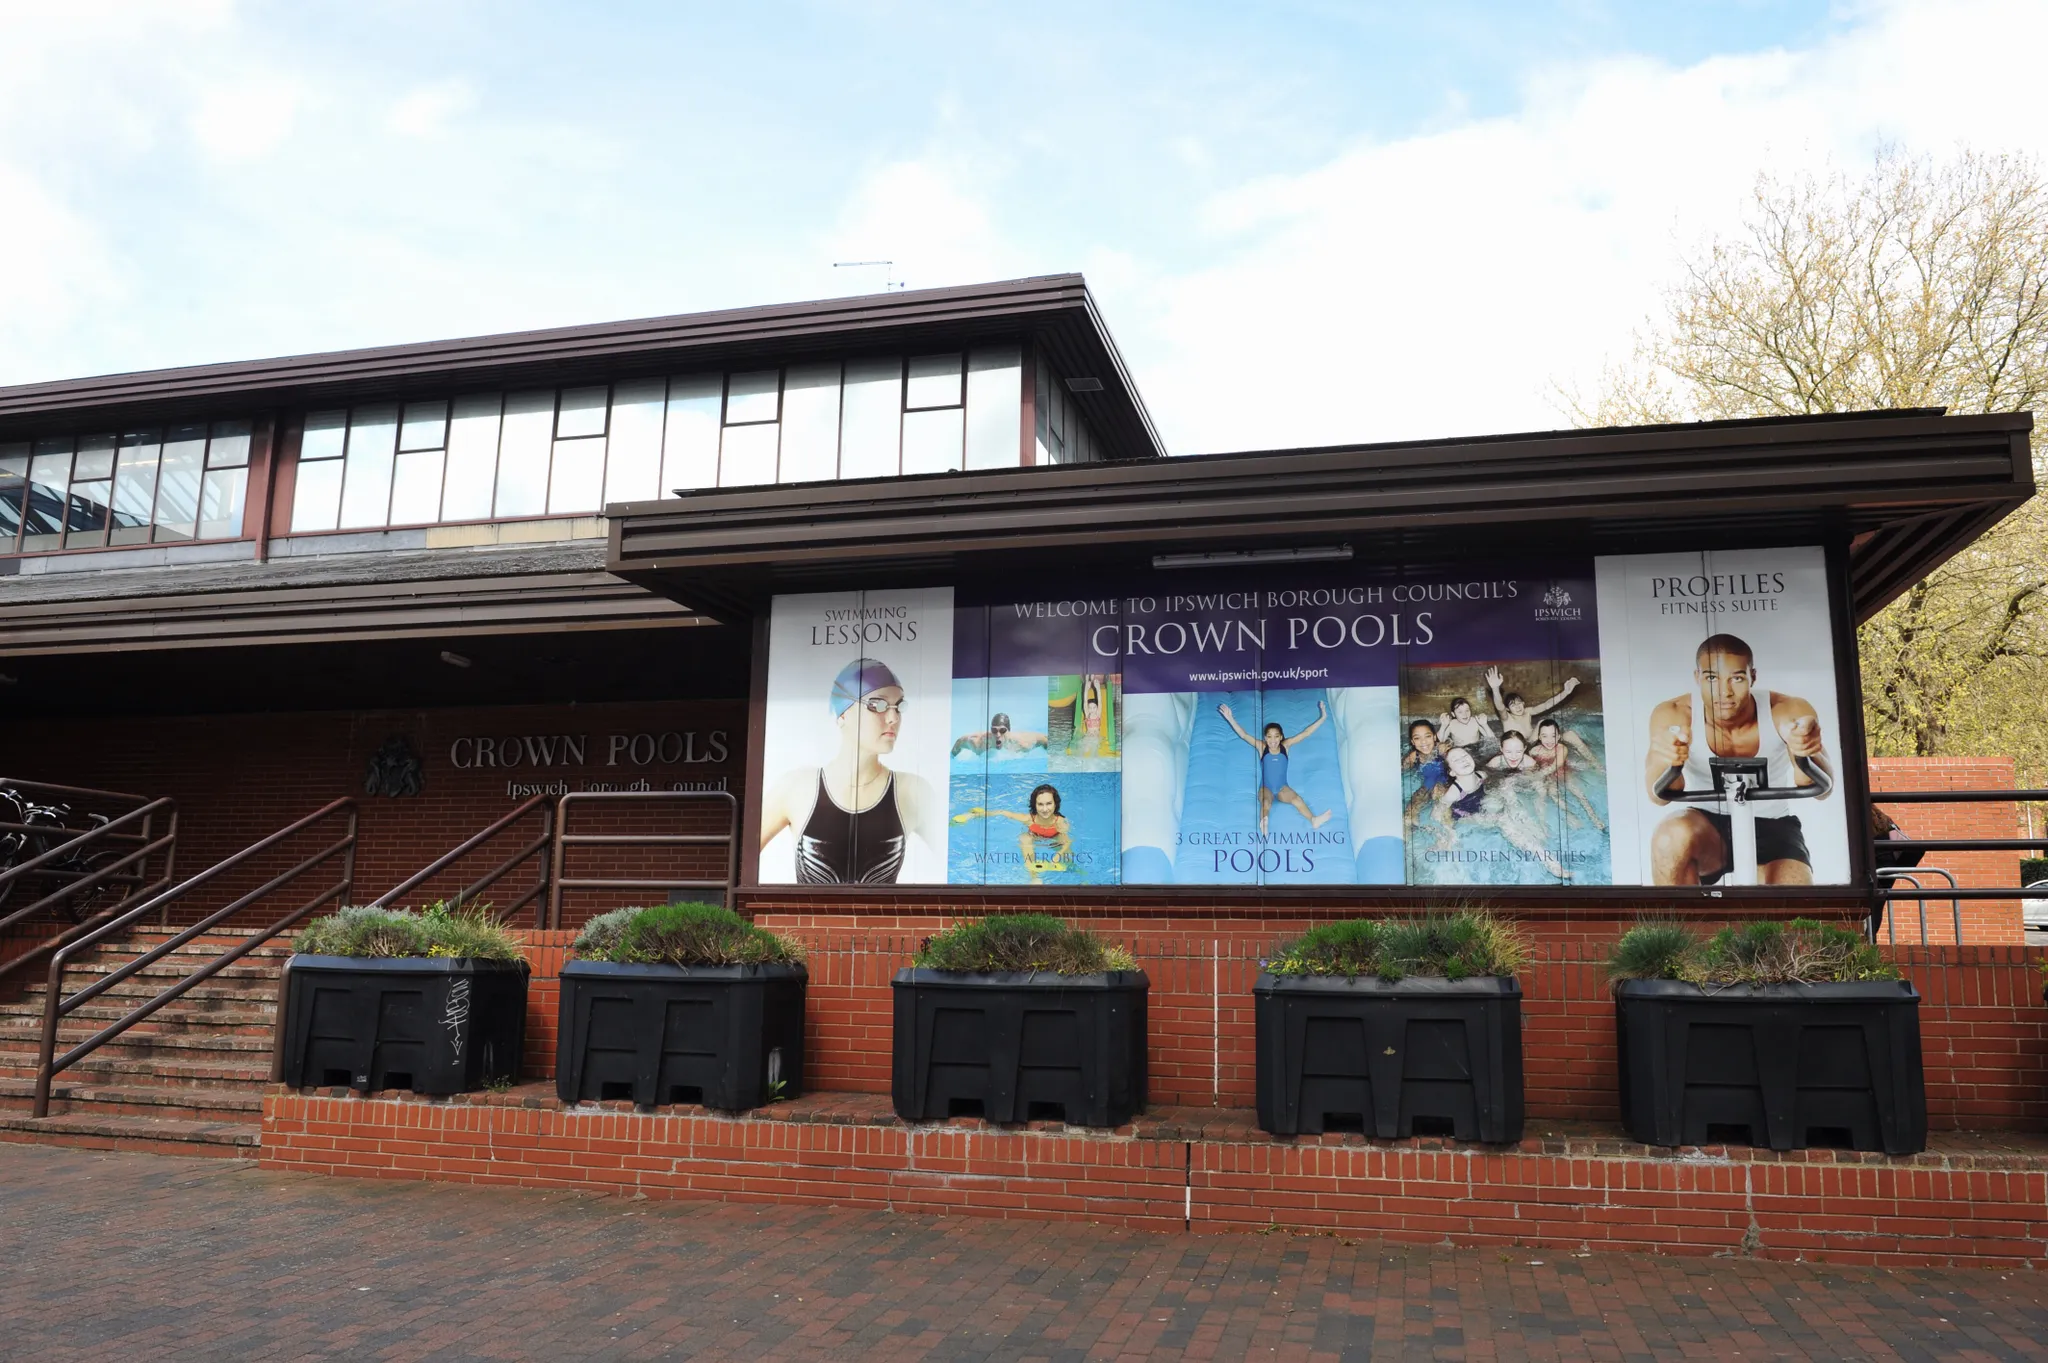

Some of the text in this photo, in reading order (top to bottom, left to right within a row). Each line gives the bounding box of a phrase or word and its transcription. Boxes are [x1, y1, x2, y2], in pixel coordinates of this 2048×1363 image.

[1652, 572, 1785, 598] PROFILES
[1014, 580, 1518, 619] WELCOME TO IPSWICH BOROUGH COUNCIL'S
[1661, 598, 1778, 615] FITNESS SUITE
[825, 606, 907, 622] SWIMMING
[1534, 607, 1581, 617] IPSWICH
[811, 621, 917, 645] LESSONS
[1092, 612, 1434, 657] CROWN POOLS
[1189, 666, 1328, 683] www.ipswich.gov.uk/sport
[450, 730, 729, 768] CROWN POOLS
[506, 780, 568, 800] Ipswich
[1175, 831, 1345, 846] 3 GREAT SWIMMING
[974, 851, 1093, 864] WATER AEROBICS
[1213, 848, 1315, 873] POOLS
